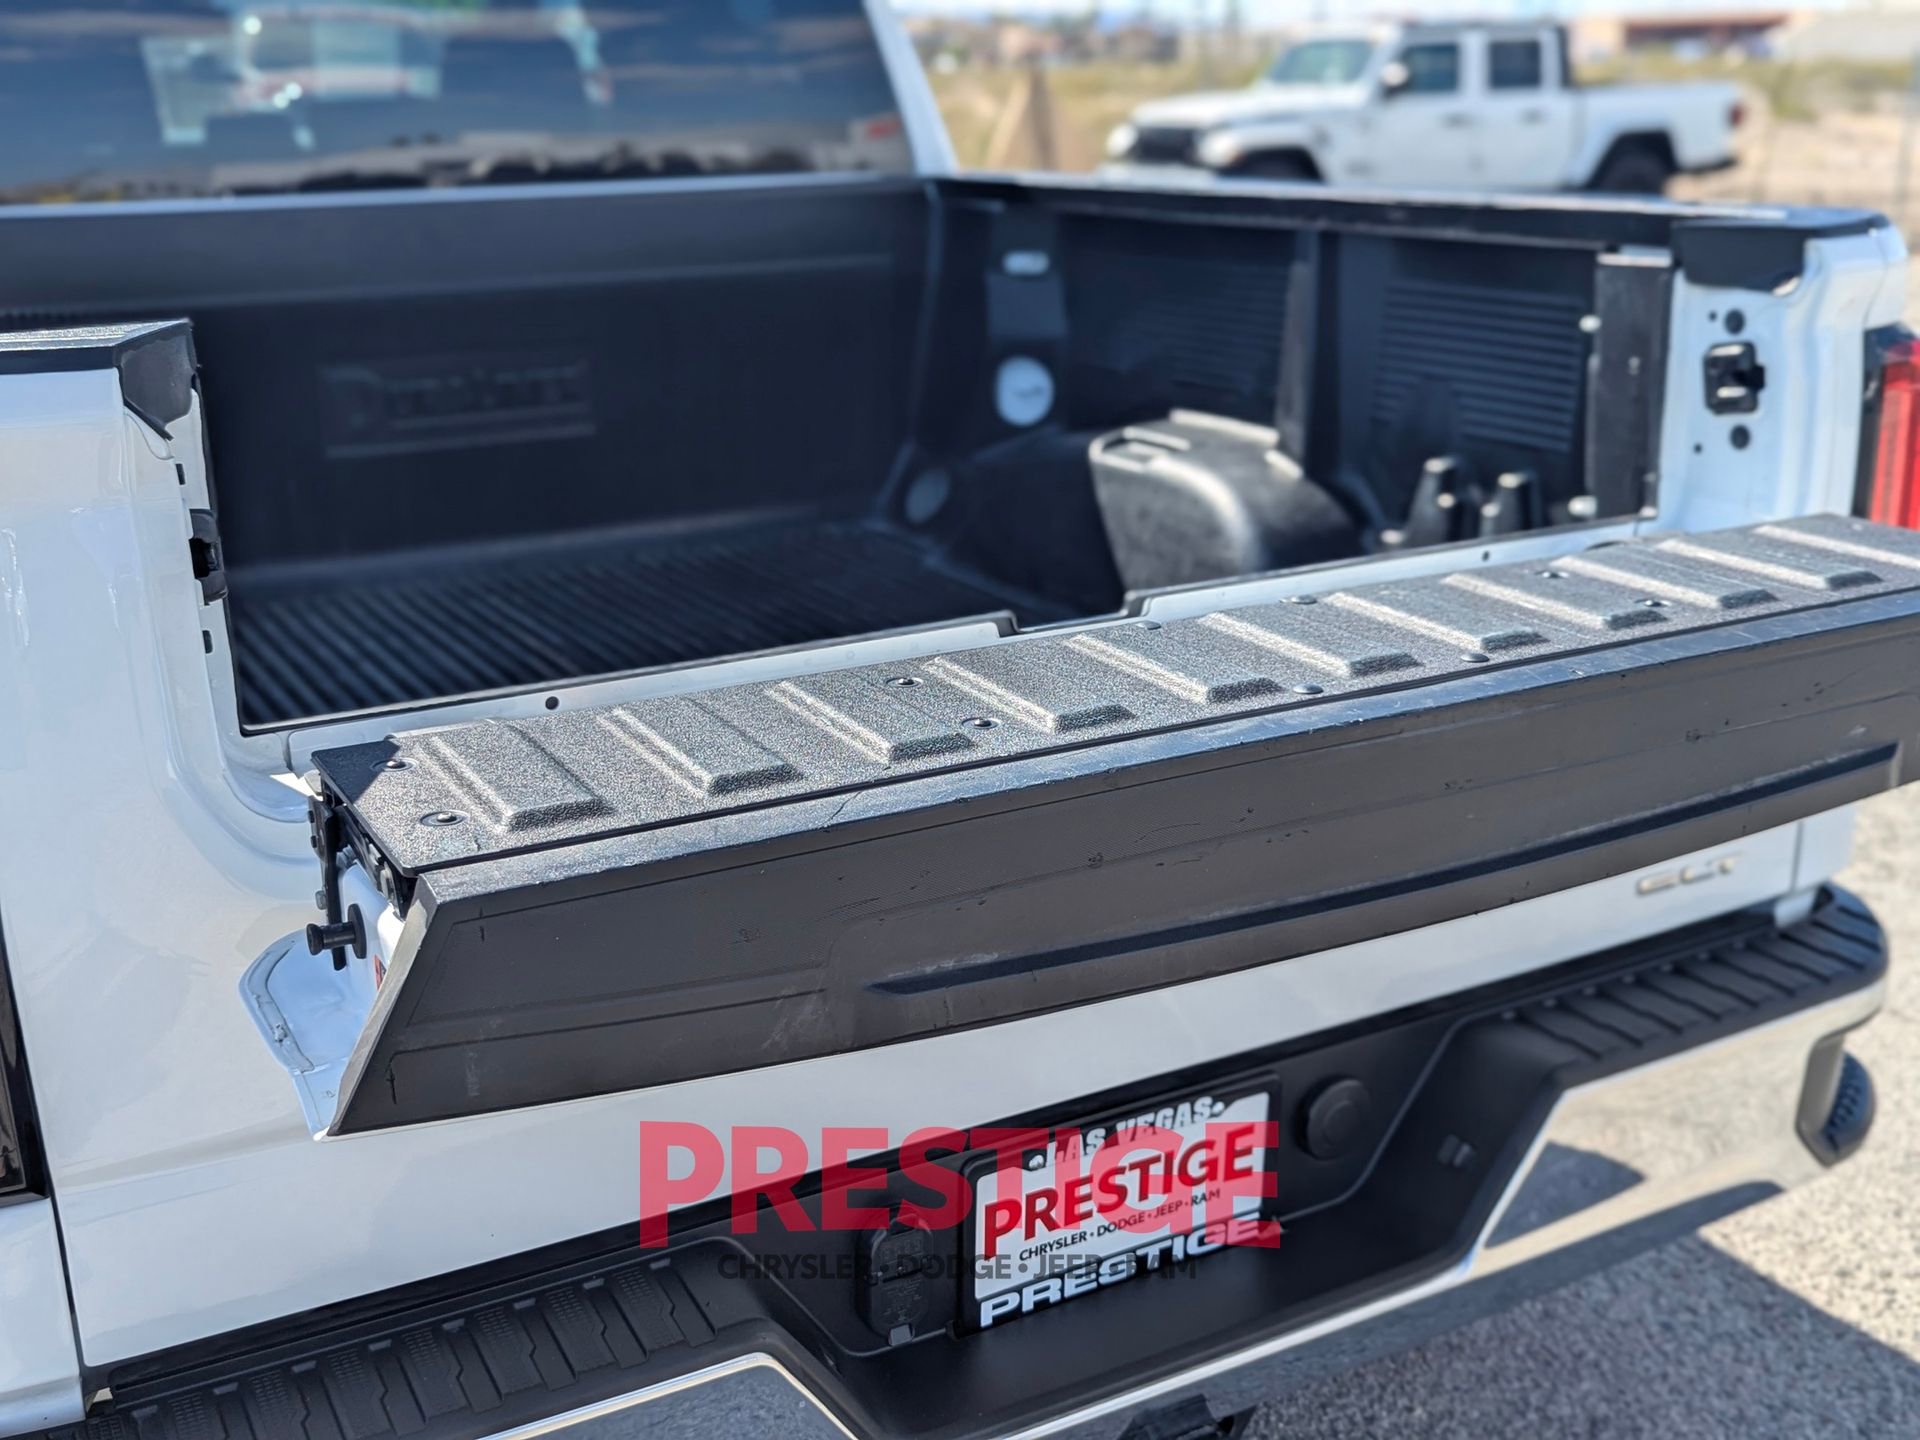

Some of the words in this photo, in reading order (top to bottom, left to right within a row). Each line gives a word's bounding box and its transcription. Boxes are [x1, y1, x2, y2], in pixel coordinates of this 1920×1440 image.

[983, 1123, 1256, 1261] PRESTIGE
[1019, 1230, 1087, 1261] CHRYSLER
[1096, 1213, 1145, 1237] DODGE
[1154, 1200, 1182, 1218] JEEP
[1190, 1188, 1220, 1206] RAM
[980, 1212, 1262, 1327] PRESTIGE
